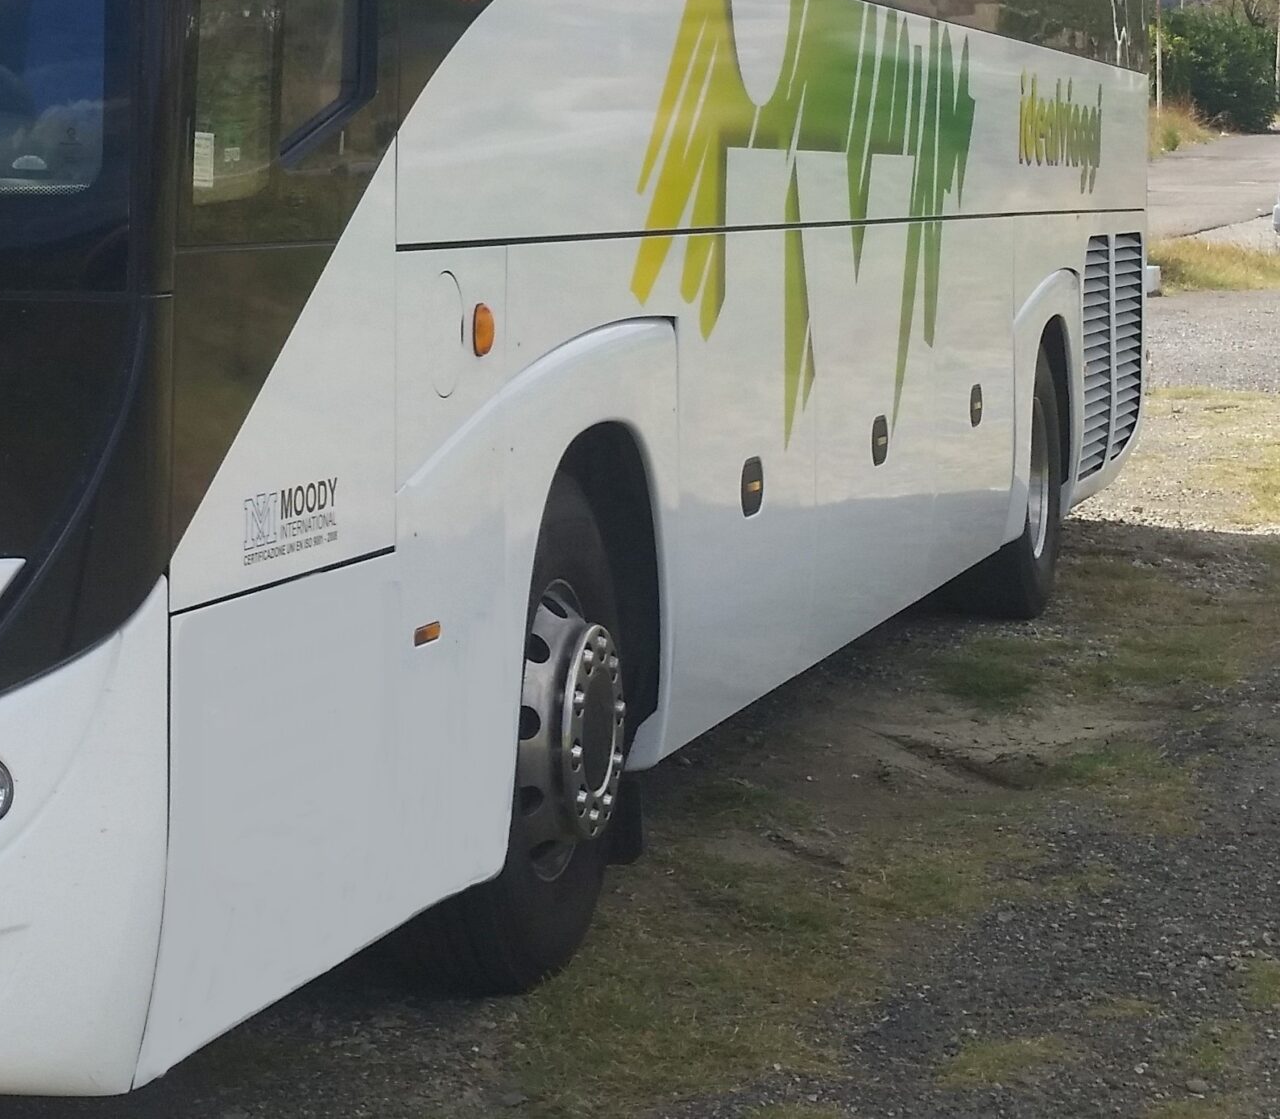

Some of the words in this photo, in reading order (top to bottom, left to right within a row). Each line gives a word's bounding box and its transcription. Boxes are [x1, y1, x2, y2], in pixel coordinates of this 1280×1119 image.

[1019, 64, 1102, 195] idealviaggi
[280, 477, 338, 520] MOODY
[280, 511, 337, 539] INTERNATIONAL
